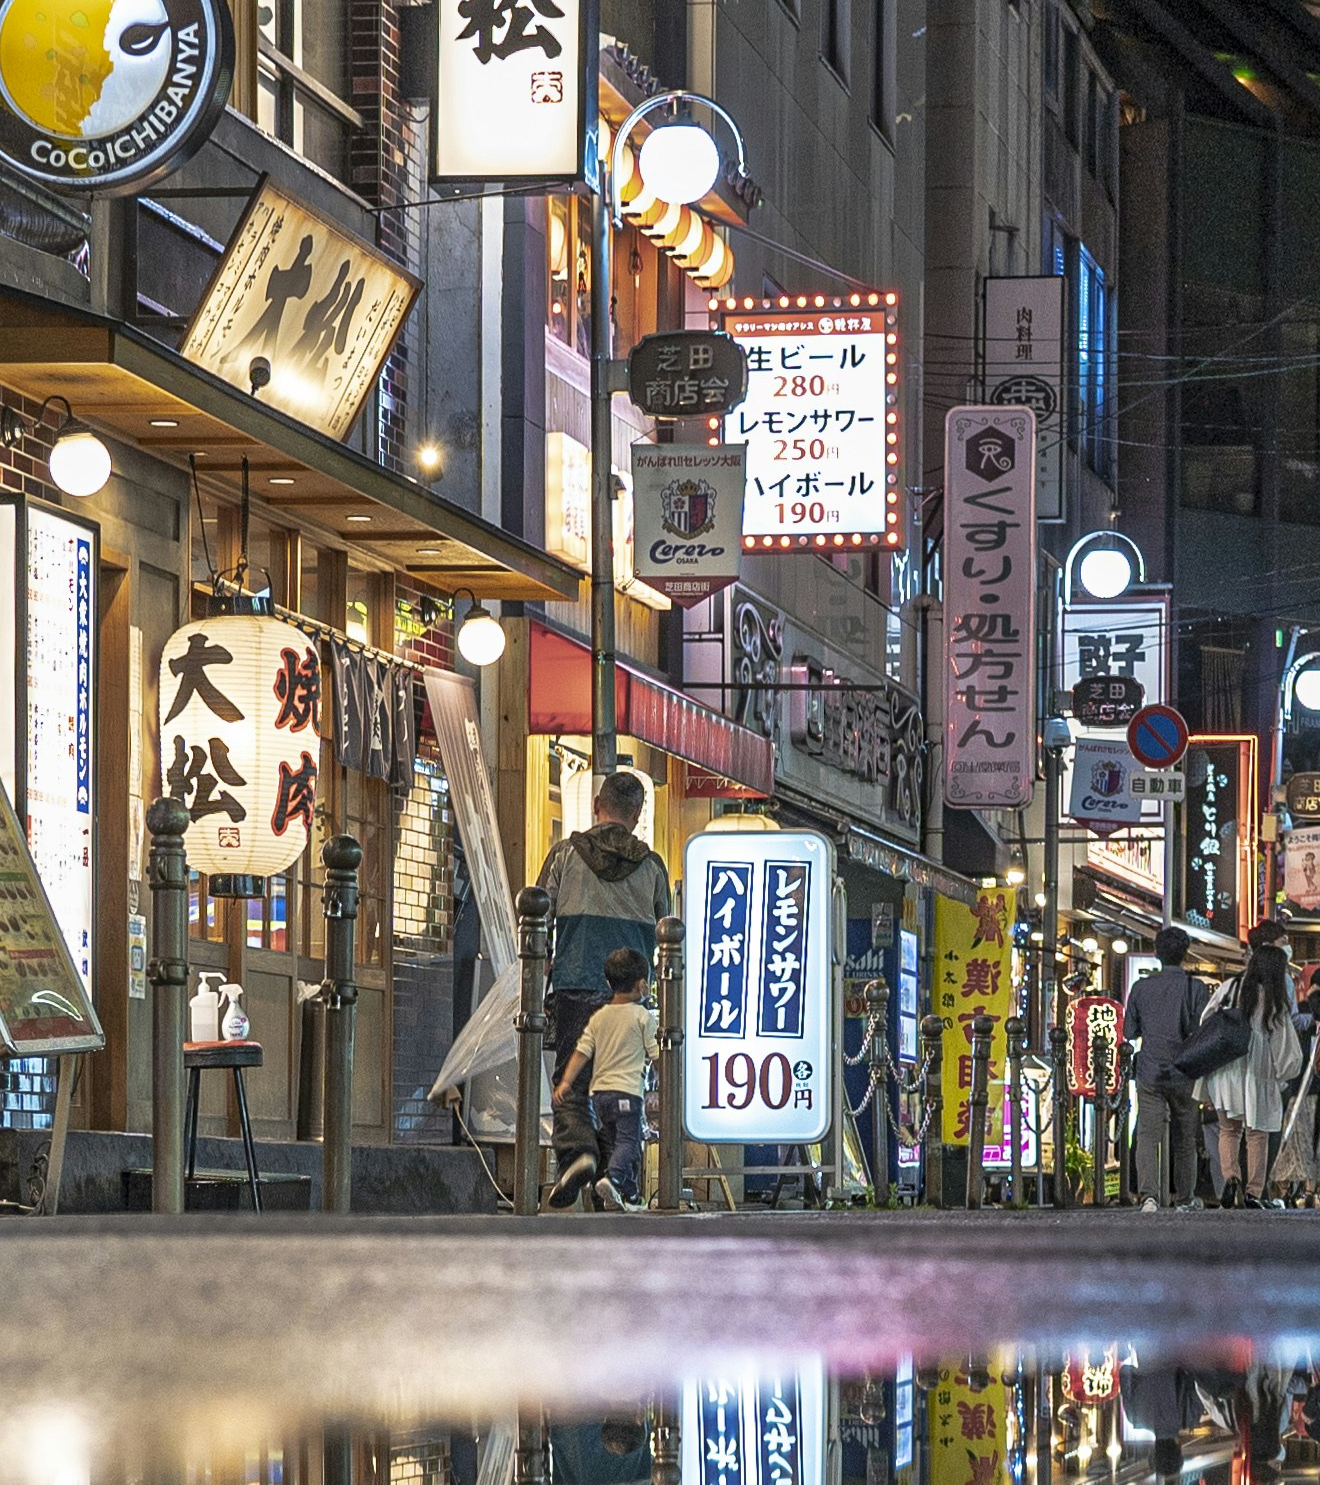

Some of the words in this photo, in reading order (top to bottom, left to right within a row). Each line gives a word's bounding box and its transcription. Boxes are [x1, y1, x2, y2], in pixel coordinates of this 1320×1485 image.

[29, 22, 200, 171] CoCoICHIBANYA
[1015, 305, 1033, 361] 肉料理
[657, 344, 714, 372] 芝田
[747, 343, 866, 372] 生ビール
[645, 375, 730, 407] 商店会
[739, 408, 874, 435] レモンサワー
[649, 539, 726, 565] Cerezo
[954, 485, 1023, 750] くすり・処方せん
[1077, 633, 1146, 677] 餃子
[1089, 682, 1127, 700] 芝田
[163, 632, 247, 824] 大松
[271, 647, 322, 839] 焼肉
[1131, 776, 1183, 795] 自動車
[705, 869, 745, 1031] ハイボール
[766, 868, 802, 1032] レモンサワー
